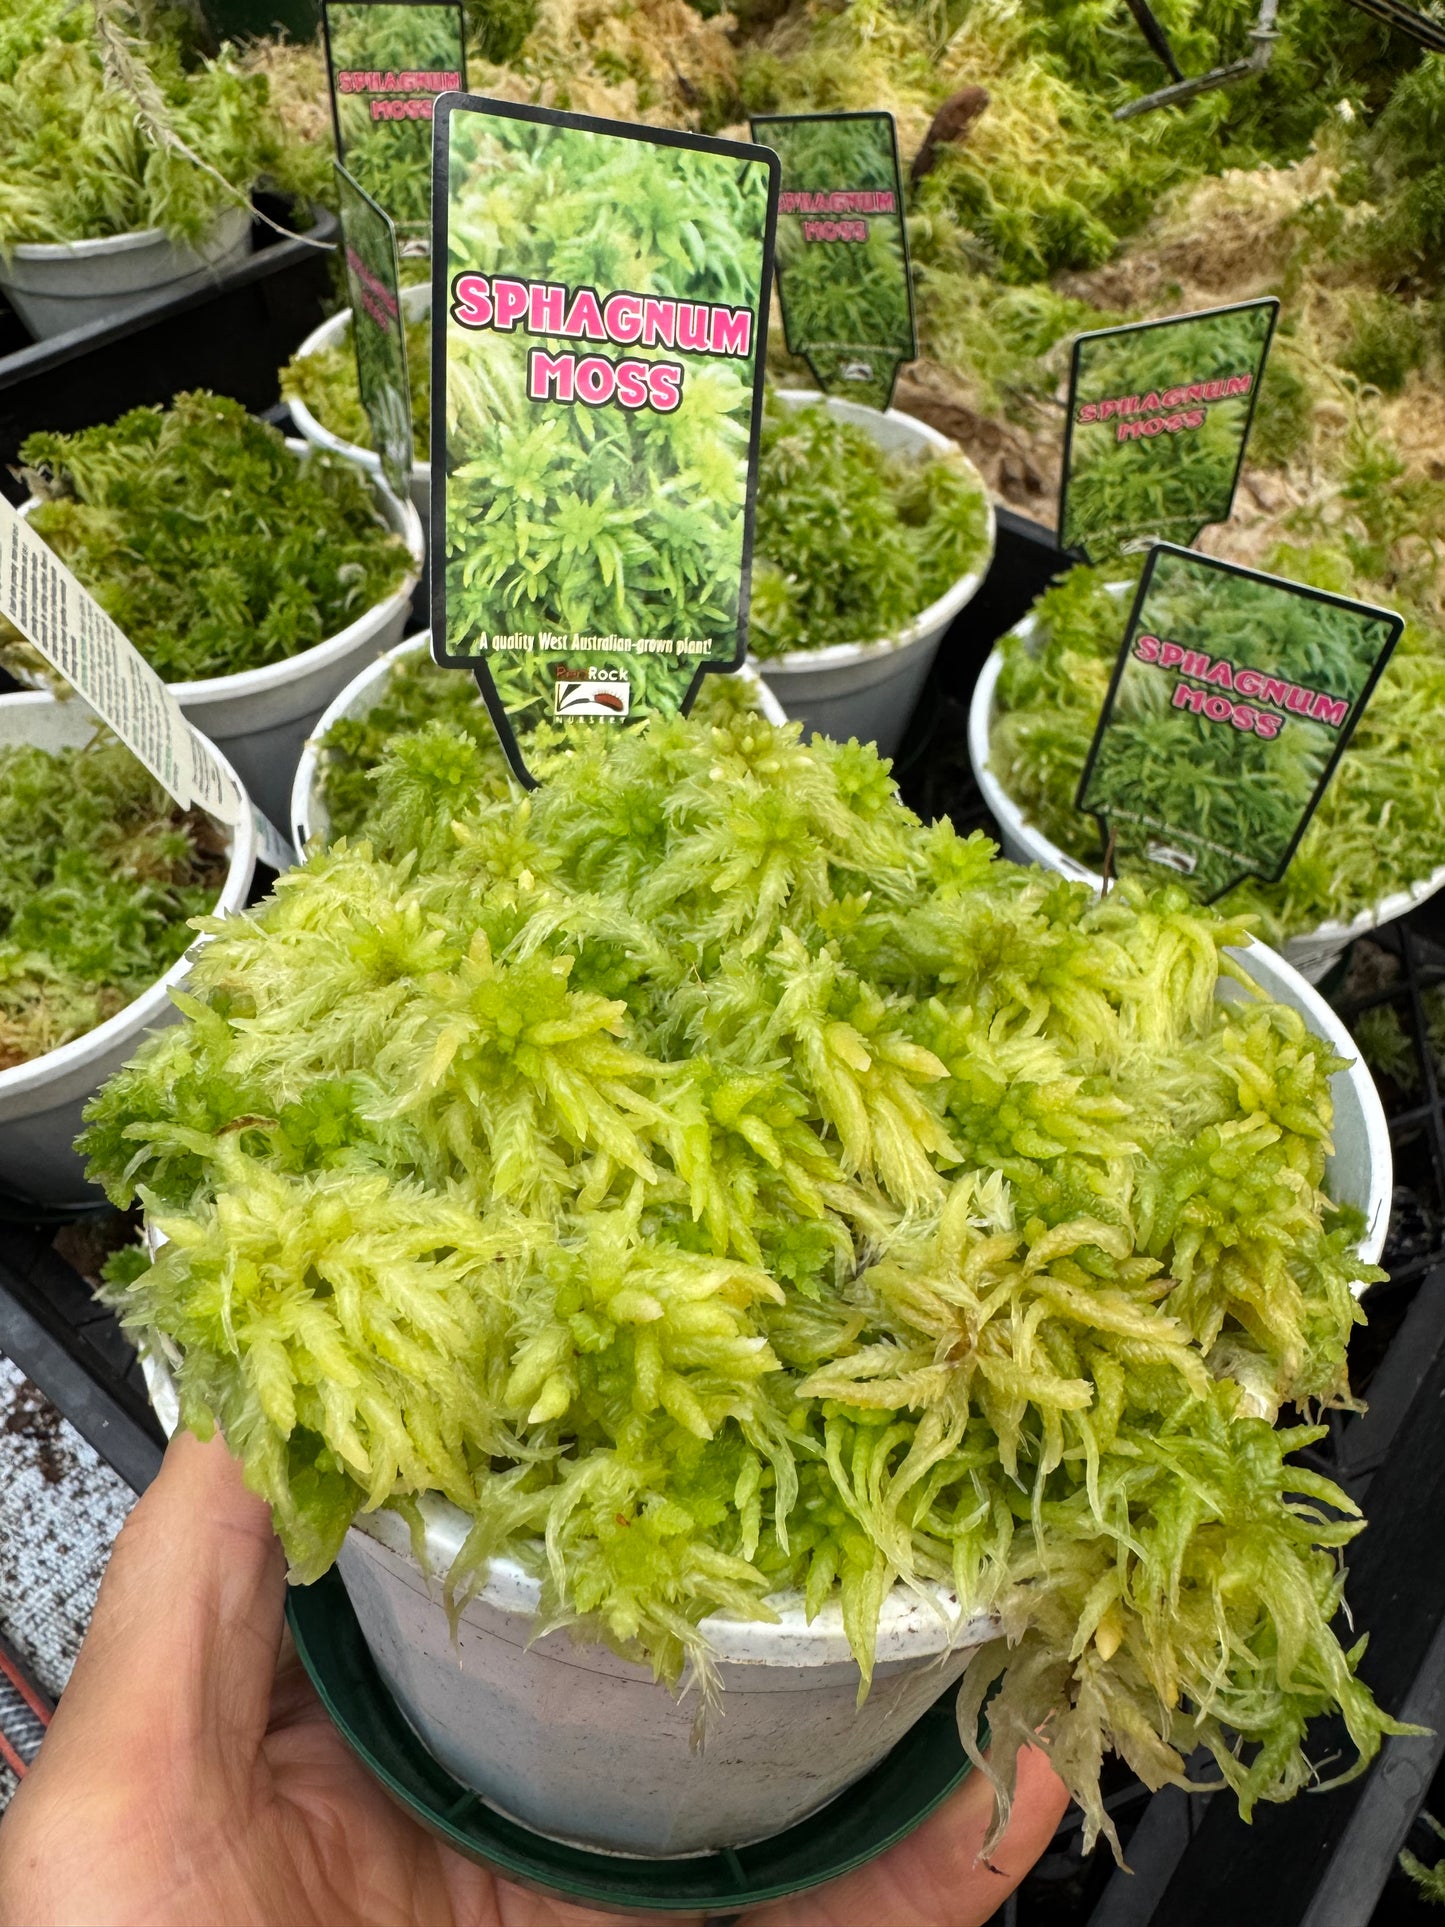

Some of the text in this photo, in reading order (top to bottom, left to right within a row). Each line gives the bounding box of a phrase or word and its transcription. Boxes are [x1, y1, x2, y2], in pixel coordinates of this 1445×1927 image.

[338, 70, 461, 93] SPHAGNUM
[371, 99, 433, 120] MOSS
[804, 220, 867, 242] MOSS
[453, 275, 752, 357] SPHAGNUM
[529, 350, 683, 411] MOSS
[1077, 373, 1253, 424] SPHAGNUM
[1117, 408, 1206, 442] MOSS
[480, 631, 712, 656] A quality West Australian-grown plant!
[1134, 634, 1350, 728] SPHAGNUM
[1171, 683, 1285, 739] MOSS
